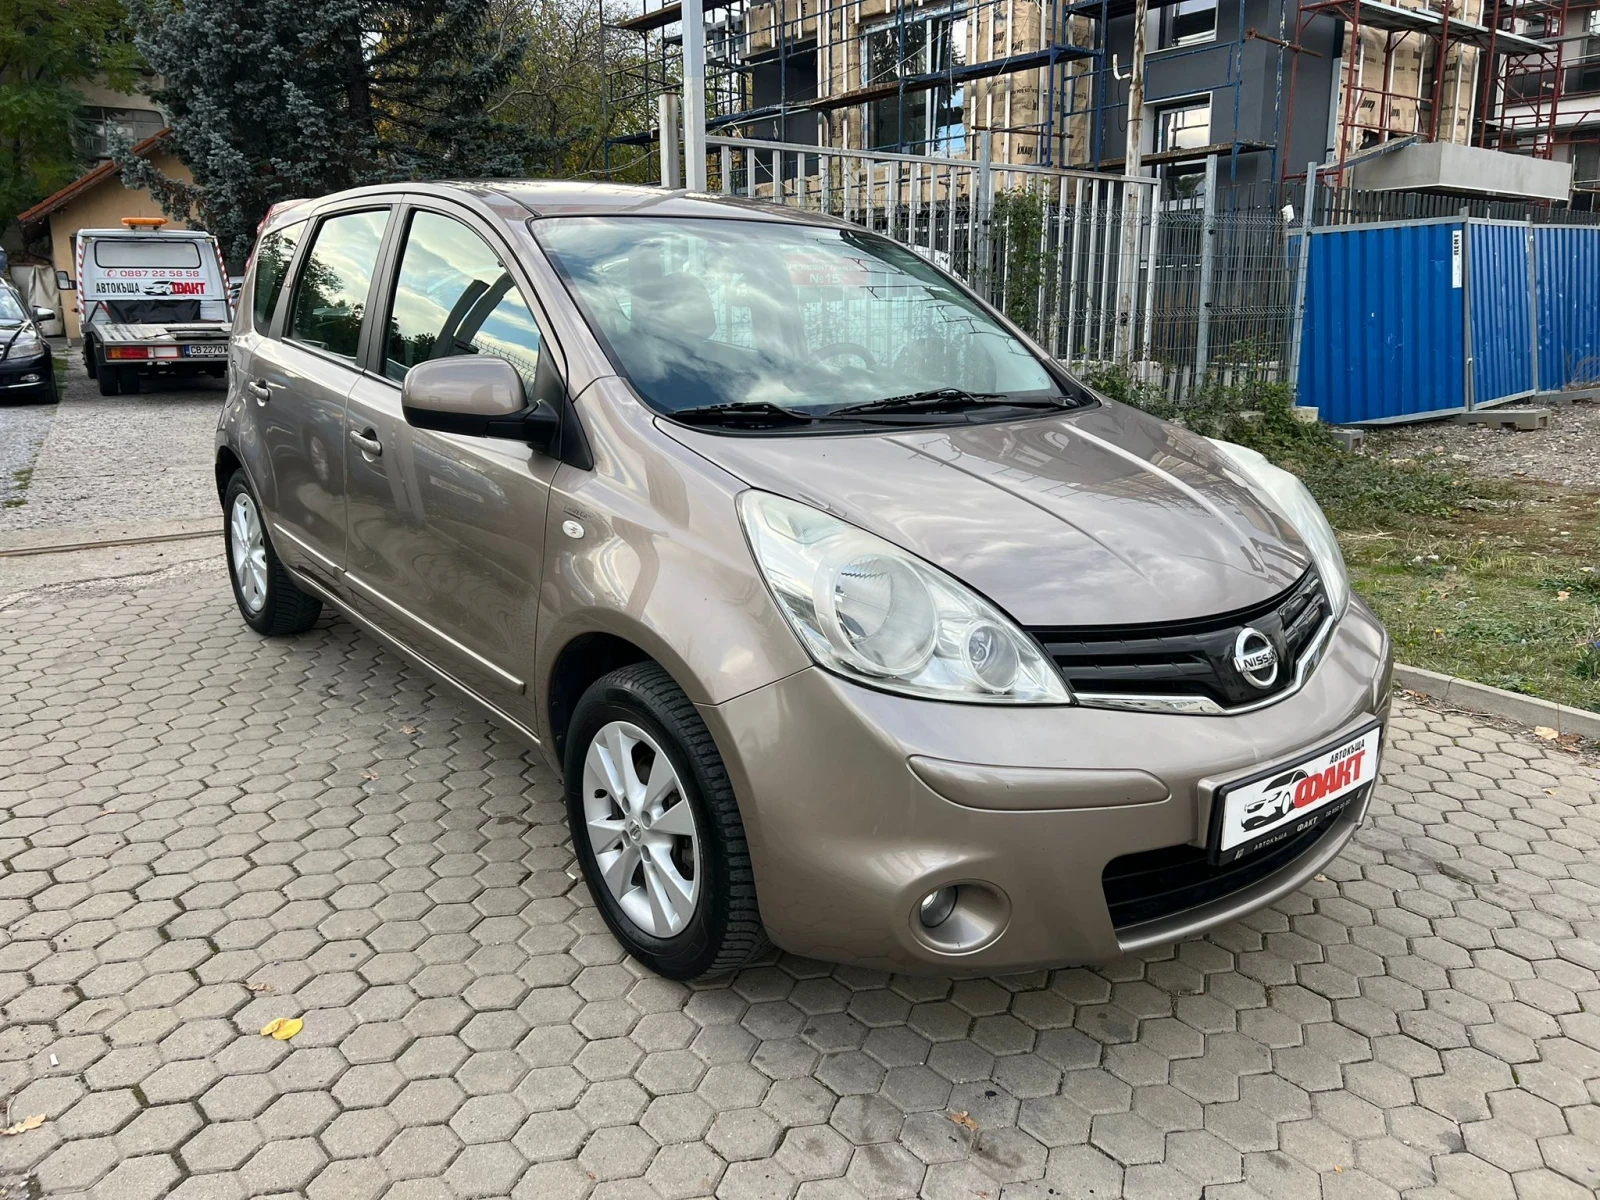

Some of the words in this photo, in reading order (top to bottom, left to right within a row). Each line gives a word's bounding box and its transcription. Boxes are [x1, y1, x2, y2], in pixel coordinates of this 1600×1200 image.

[120, 269, 148, 277] 0887
[151, 269, 166, 277] 22
[169, 269, 183, 277] 58
[185, 269, 200, 277] 58
[95, 282, 140, 295] АВТОКЪЩА
[171, 281, 206, 295] ФАКТ
[1329, 738, 1365, 765] АВТОКЪЩА
[1293, 749, 1366, 809] ФАКТ
[1296, 816, 1319, 832] ФАКТ
